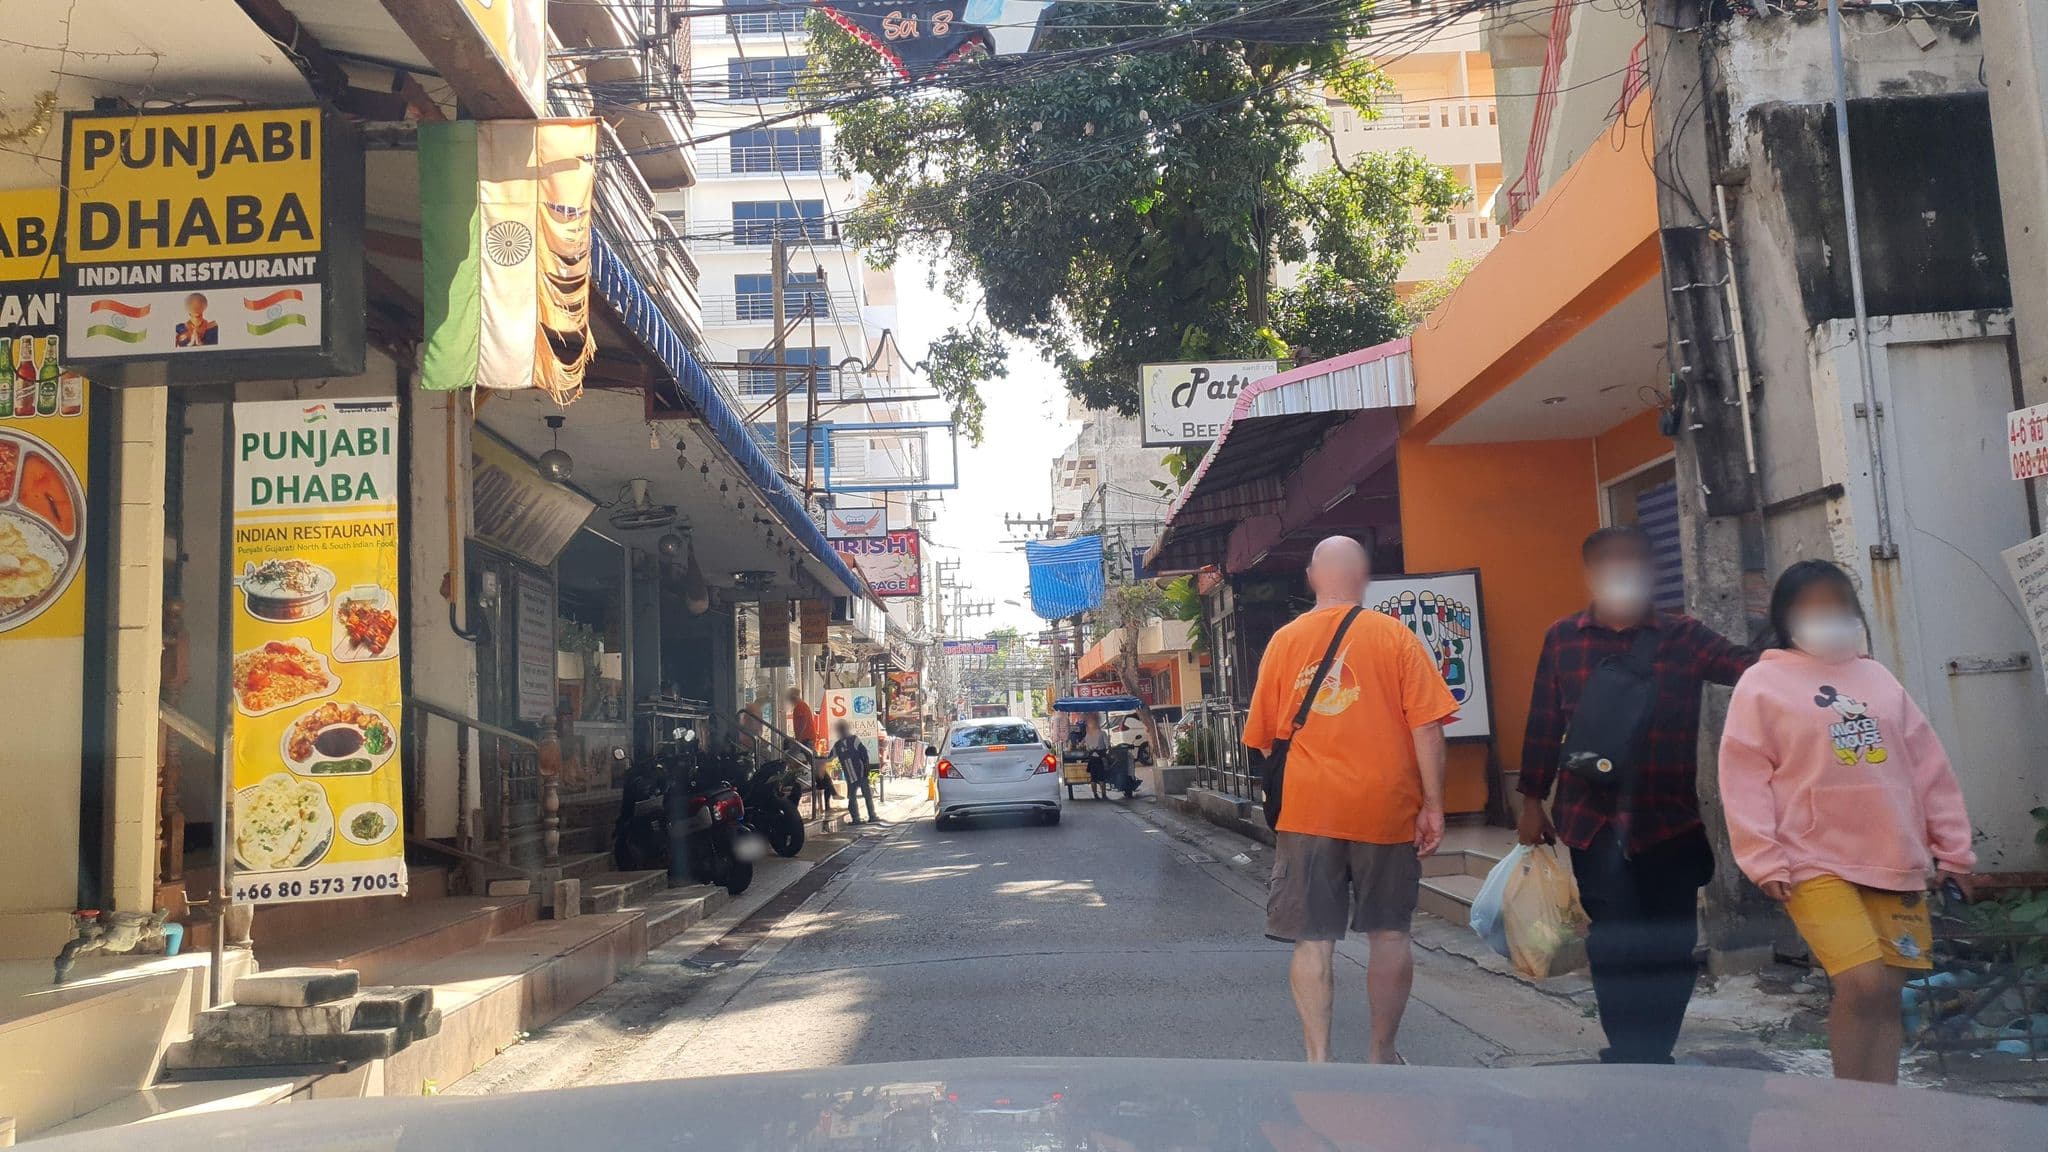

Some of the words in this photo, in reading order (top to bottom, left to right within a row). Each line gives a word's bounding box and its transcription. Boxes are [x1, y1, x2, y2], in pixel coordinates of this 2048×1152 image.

[882, 11, 919, 40] Soi
[932, 10, 953, 37] 8
[84, 120, 311, 179] PUNJABI
[80, 193, 314, 251] DHABA
[78, 265, 162, 287] INDIAN
[170, 257, 316, 283] RESTAURANT
[1183, 422, 1225, 438] BEE
[242, 427, 390, 468] PUNJABI
[251, 472, 379, 506] DHABA
[236, 527, 287, 543] INDIAN
[293, 522, 394, 540] RESTAURANT
[330, 542, 351, 550] South
[1830, 718, 1878, 737] MICKEY
[1834, 731, 1883, 750] MOUSE
[236, 883, 272, 900] +66
[278, 881, 302, 897] 80
[309, 878, 345, 895] 573
[352, 873, 400, 892] 7003
